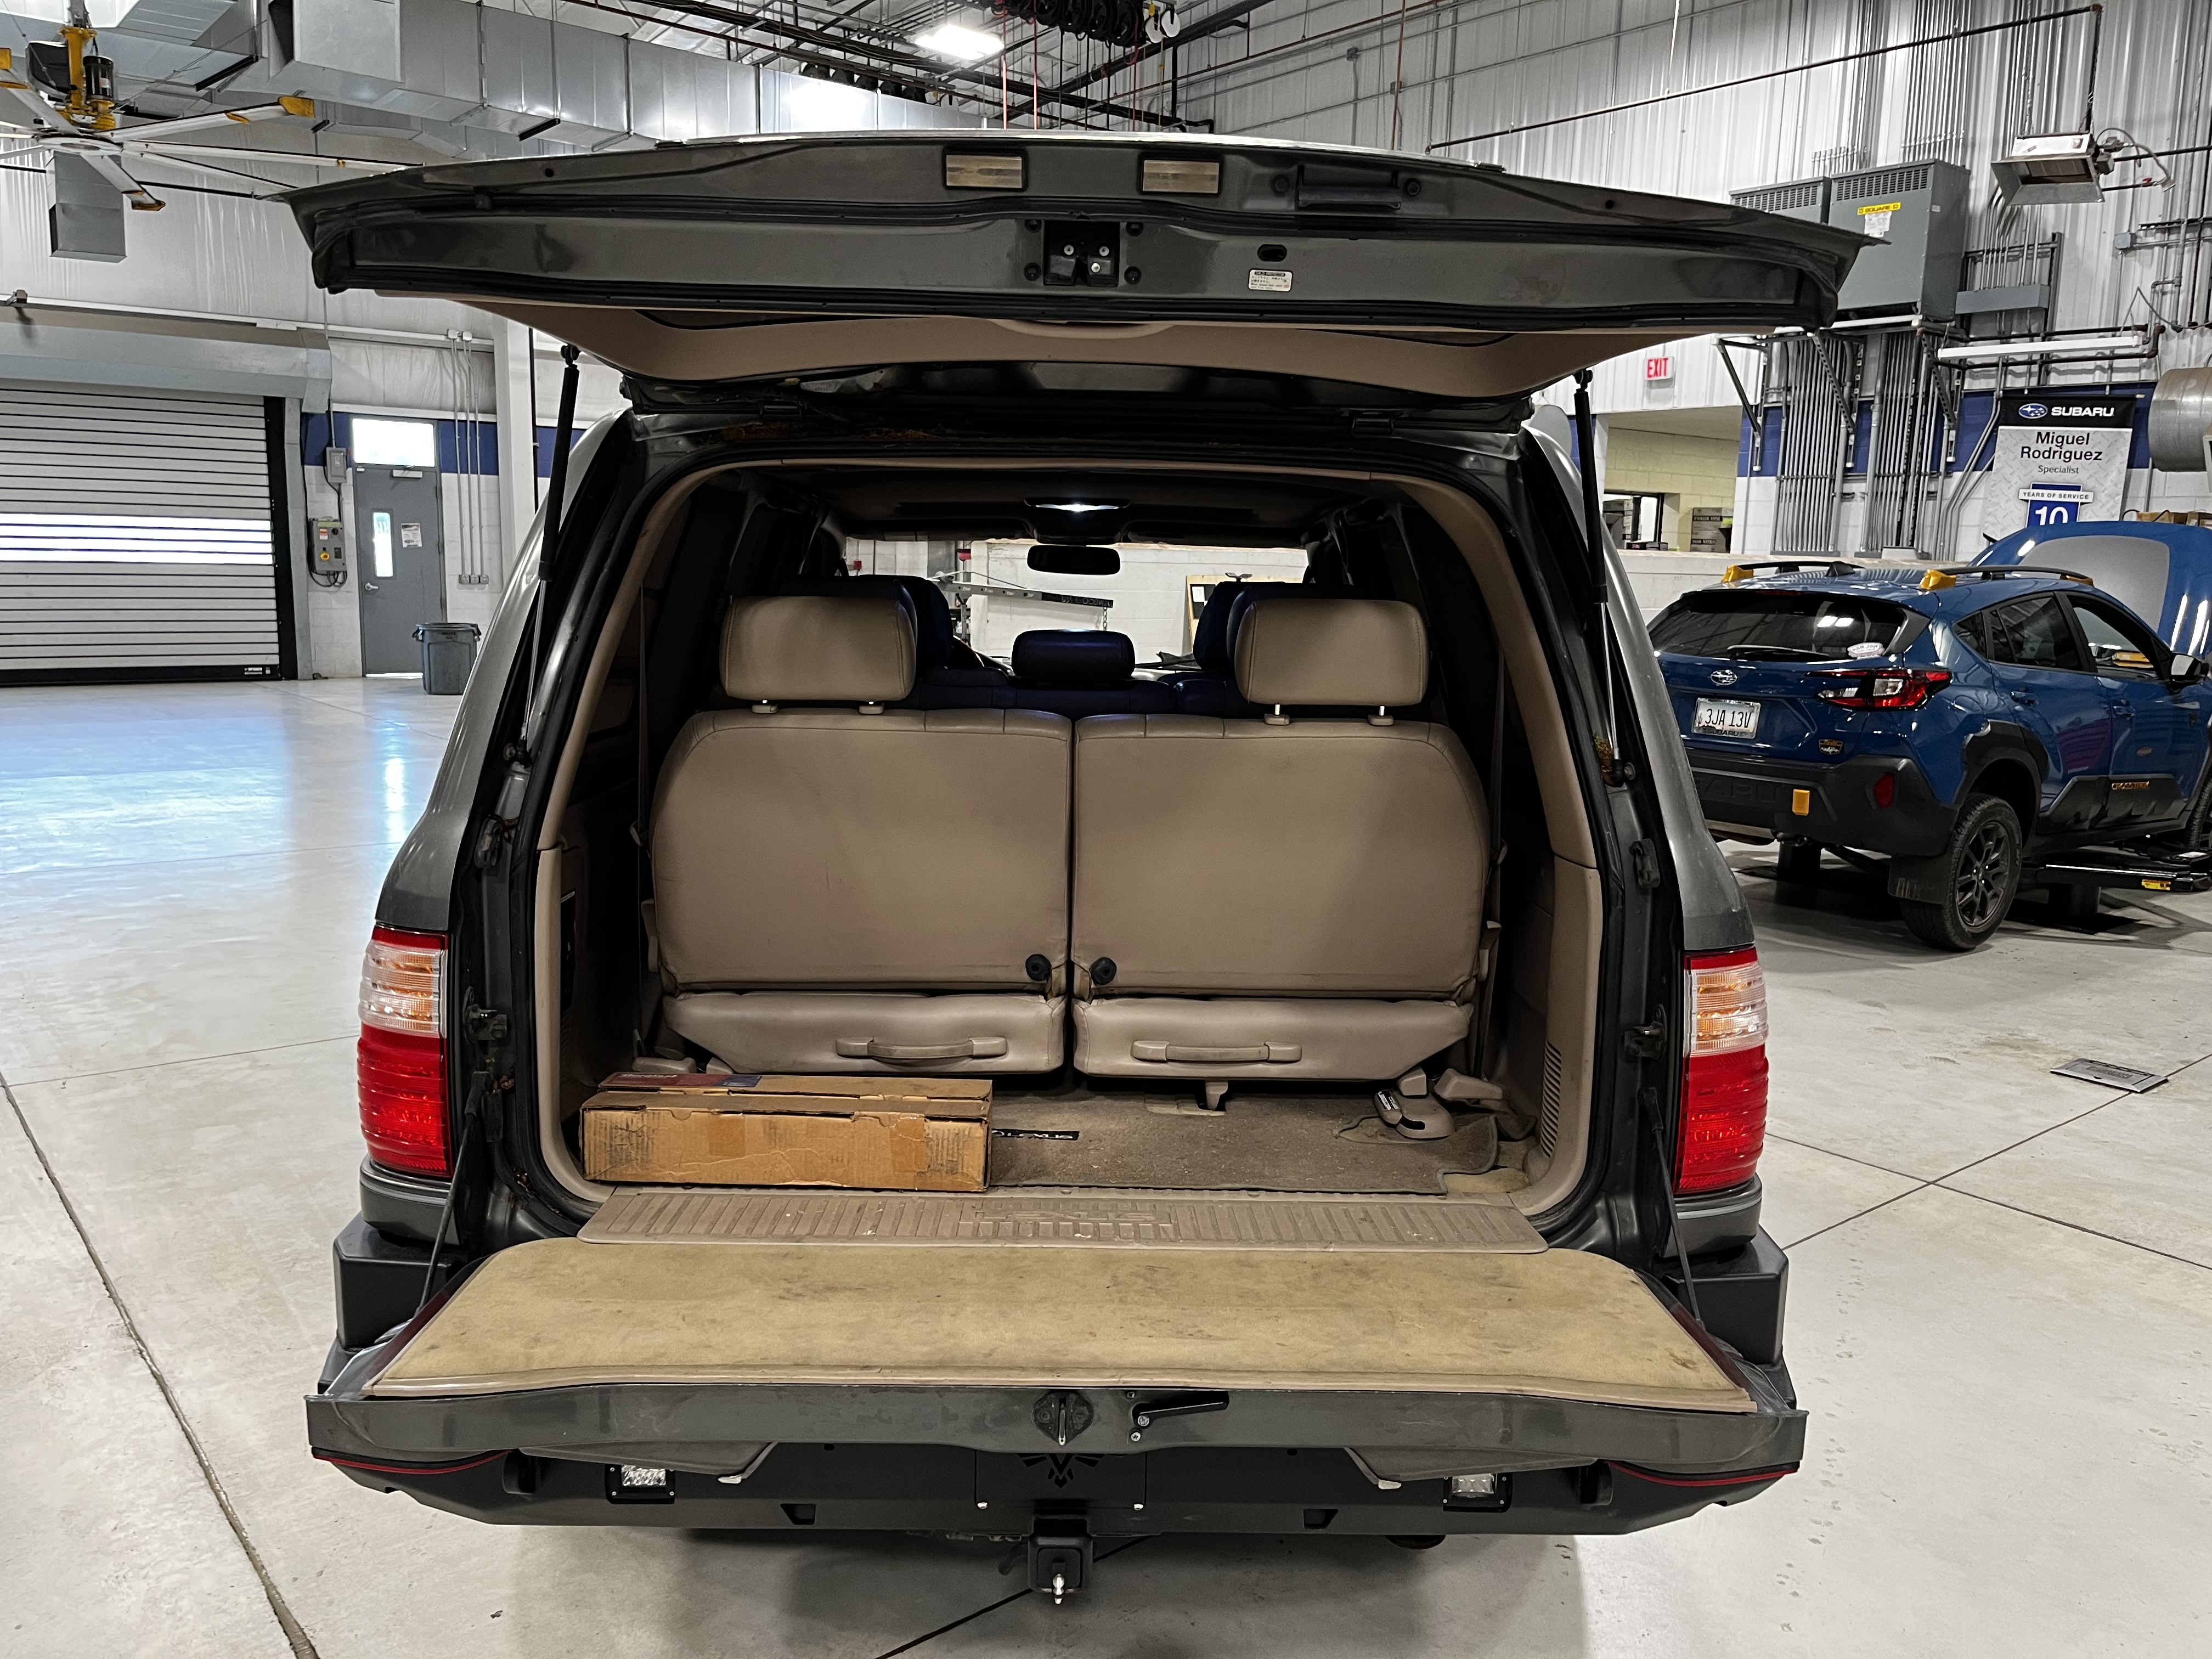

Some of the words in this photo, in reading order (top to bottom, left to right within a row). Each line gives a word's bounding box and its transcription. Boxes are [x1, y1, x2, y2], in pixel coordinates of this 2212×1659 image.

[1647, 358, 1668, 378] EXIT
[2051, 407, 2114, 416] SUBARU
[2036, 432, 2090, 448] Miguel
[2021, 446, 2102, 463] Rodriguez
[2038, 465, 2079, 474] Specialist
[2035, 506, 2068, 526] 10
[1705, 708, 1726, 726] 3JA
[1728, 710, 1752, 728] 13V
[1707, 728, 1739, 736] SUBARU
